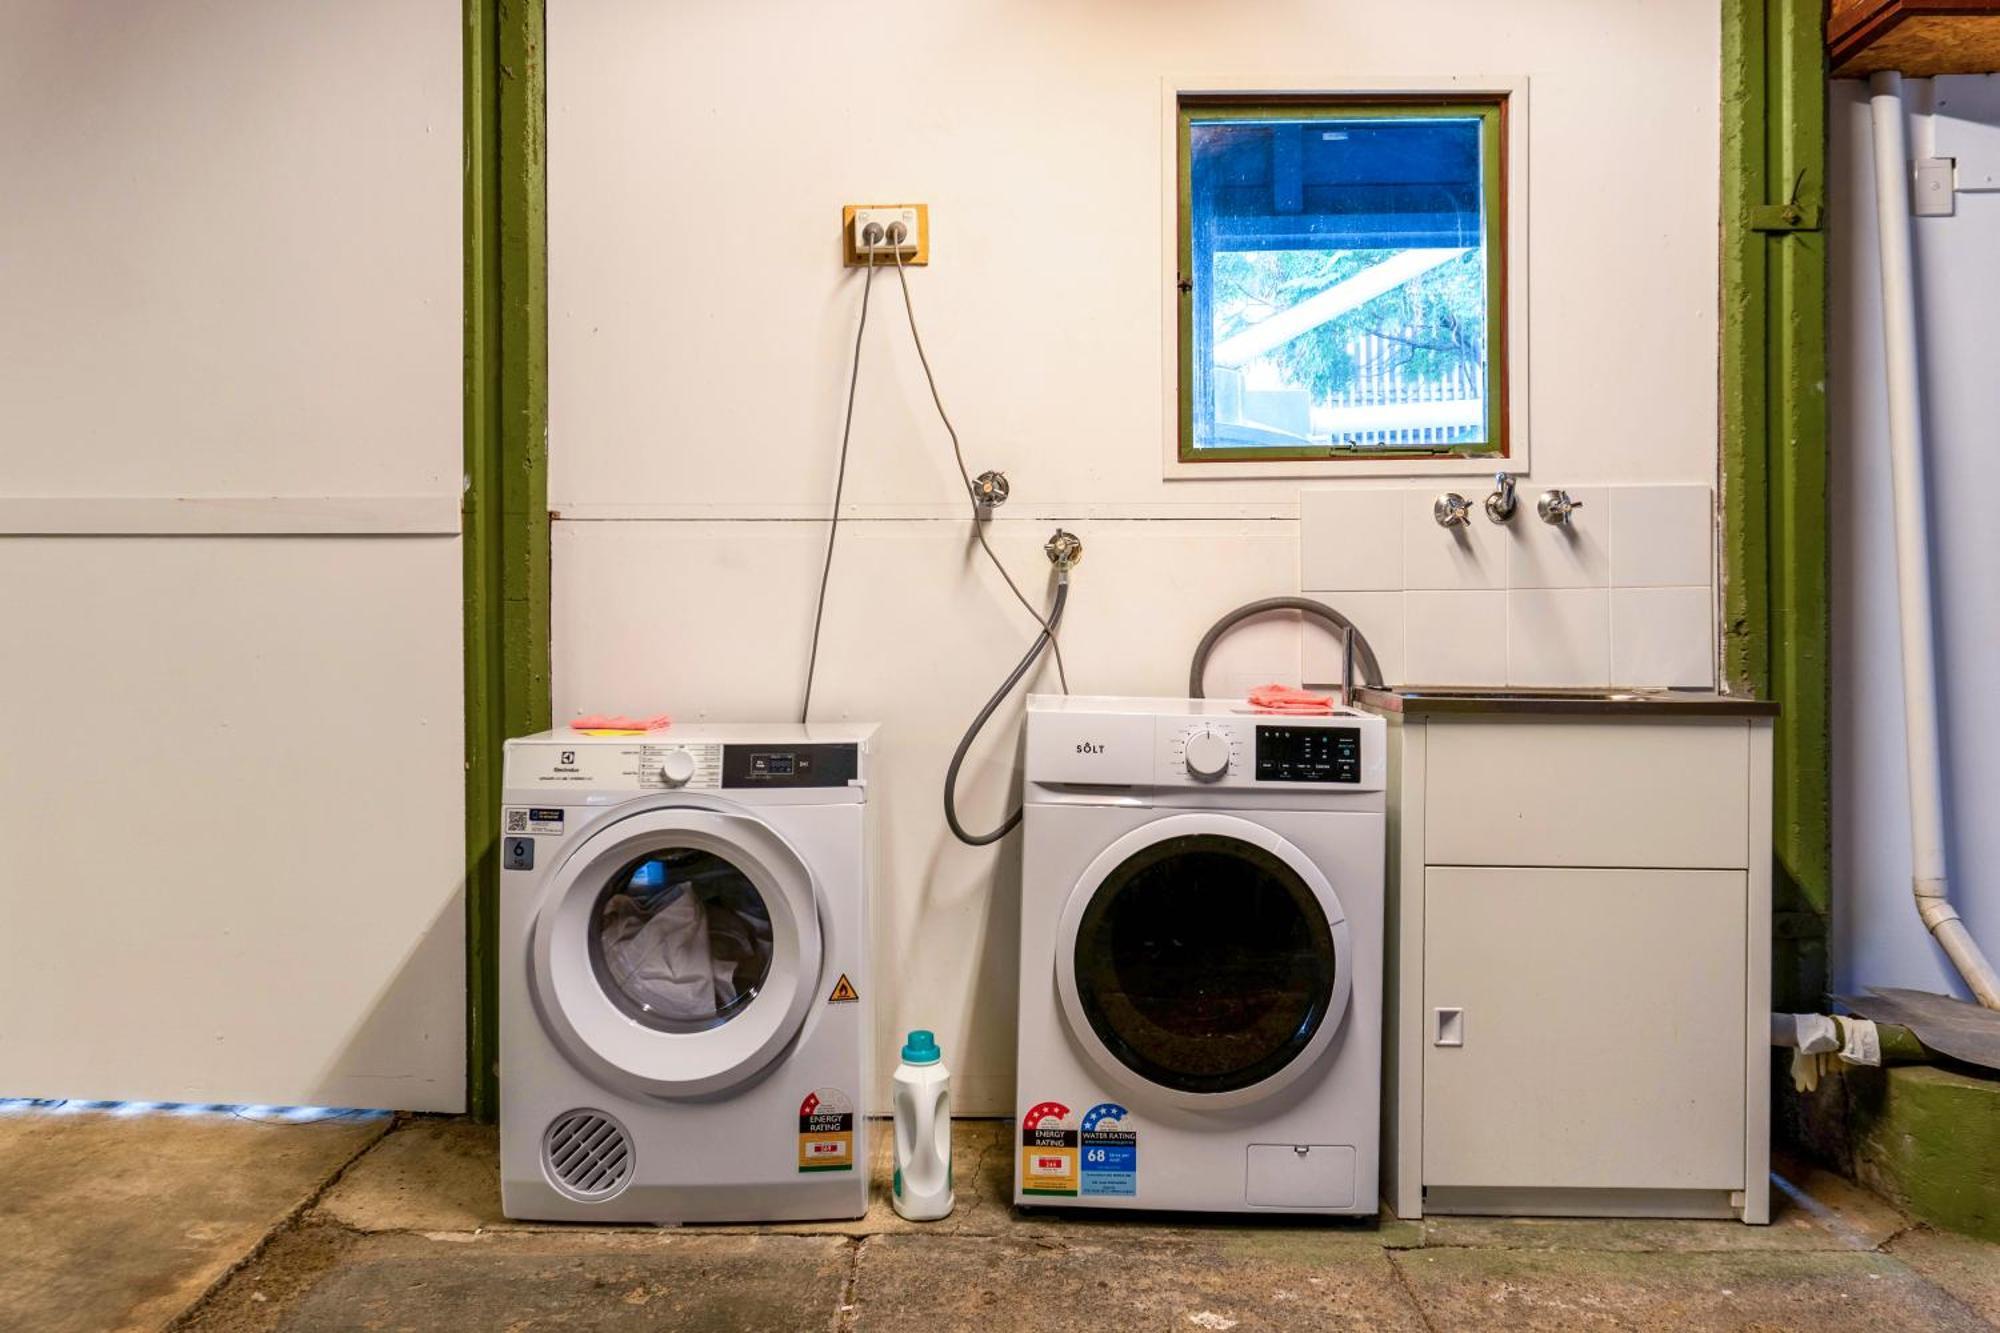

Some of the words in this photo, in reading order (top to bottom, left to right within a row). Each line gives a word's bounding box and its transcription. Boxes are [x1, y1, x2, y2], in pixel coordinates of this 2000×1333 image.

[513, 841, 525, 857] 6
[810, 1115, 842, 1123] ENERGY
[810, 1123, 841, 1132] RATING
[1035, 1130, 1065, 1138] ENERGY
[1083, 1132, 1108, 1140] WATER
[1109, 1132, 1136, 1140] RATING
[1035, 1140, 1065, 1148] RATING
[1087, 1149, 1105, 1162] 68
